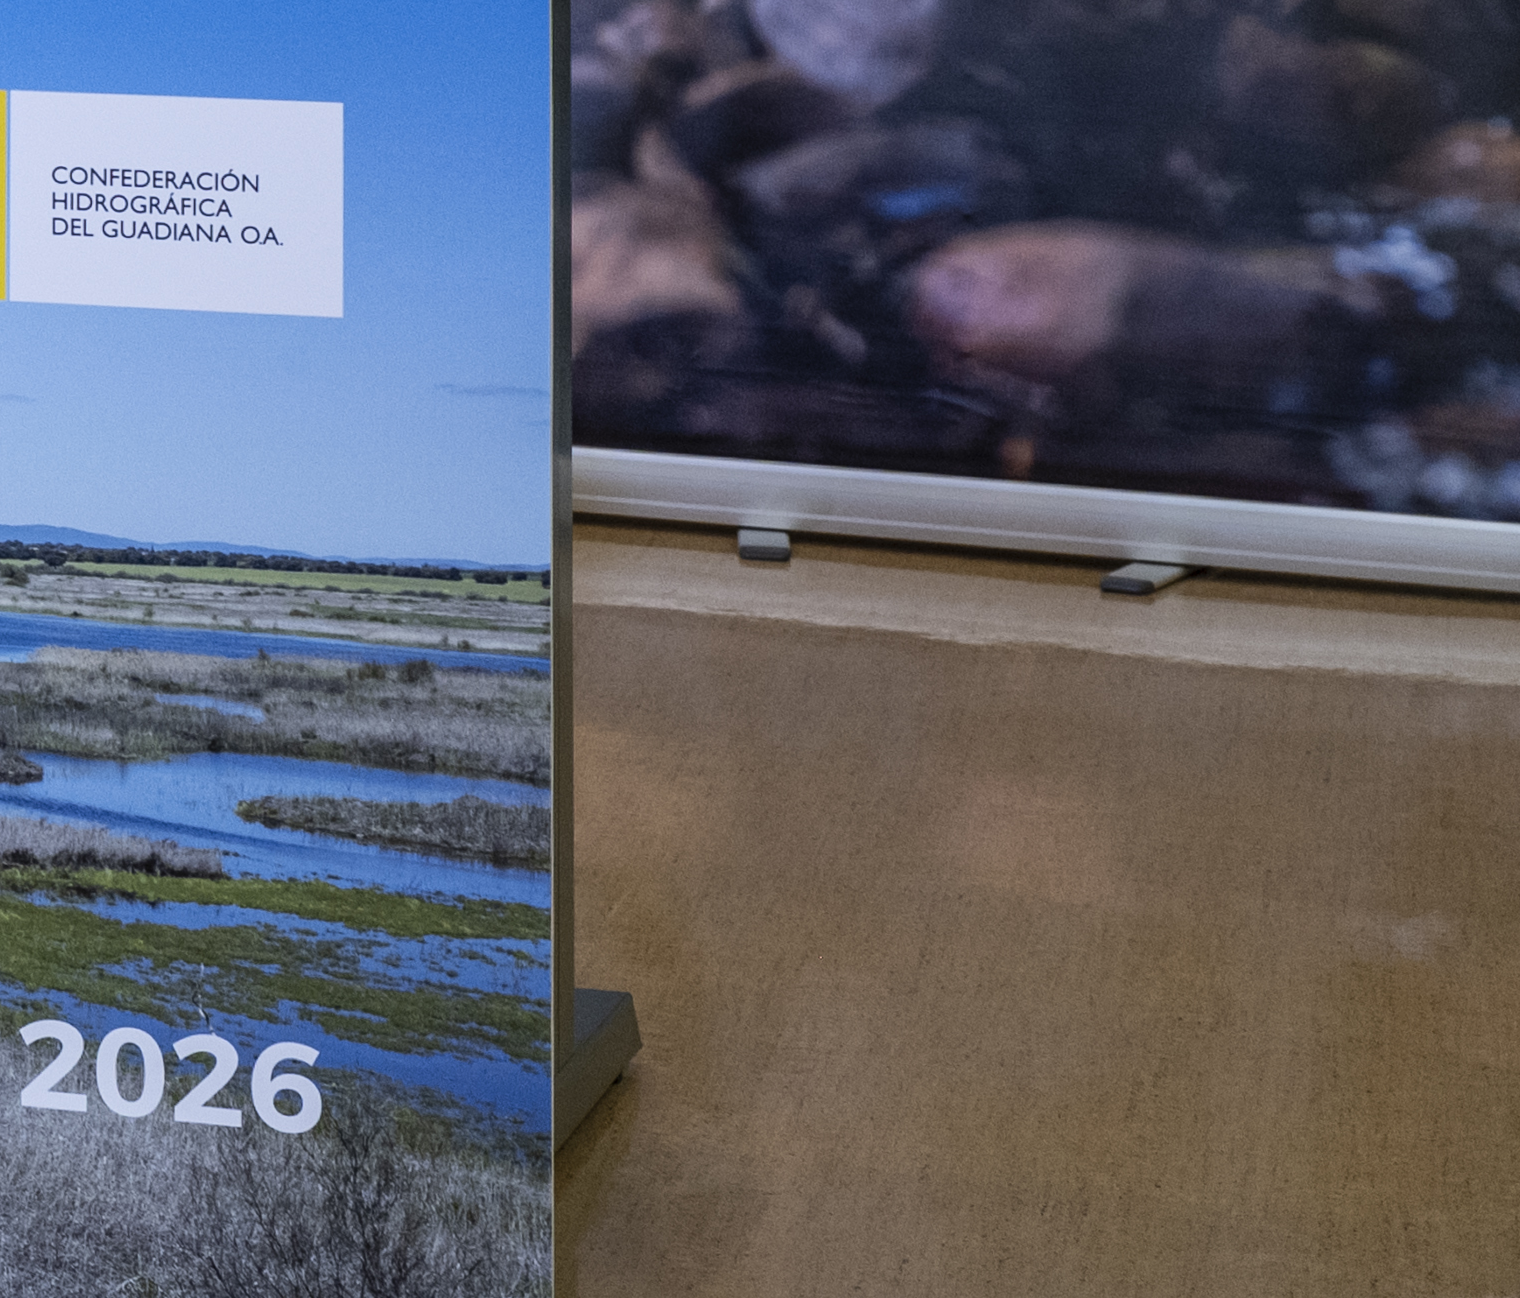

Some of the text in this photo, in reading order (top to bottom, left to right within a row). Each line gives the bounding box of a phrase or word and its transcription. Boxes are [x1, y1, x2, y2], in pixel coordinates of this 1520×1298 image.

[52, 166, 259, 193] CONFEDERACIÓN
[52, 192, 232, 217] HIDROGRÁFICA
[52, 217, 283, 246] DEL GUADIANA O.A.
[20, 1019, 323, 1134] 2026
